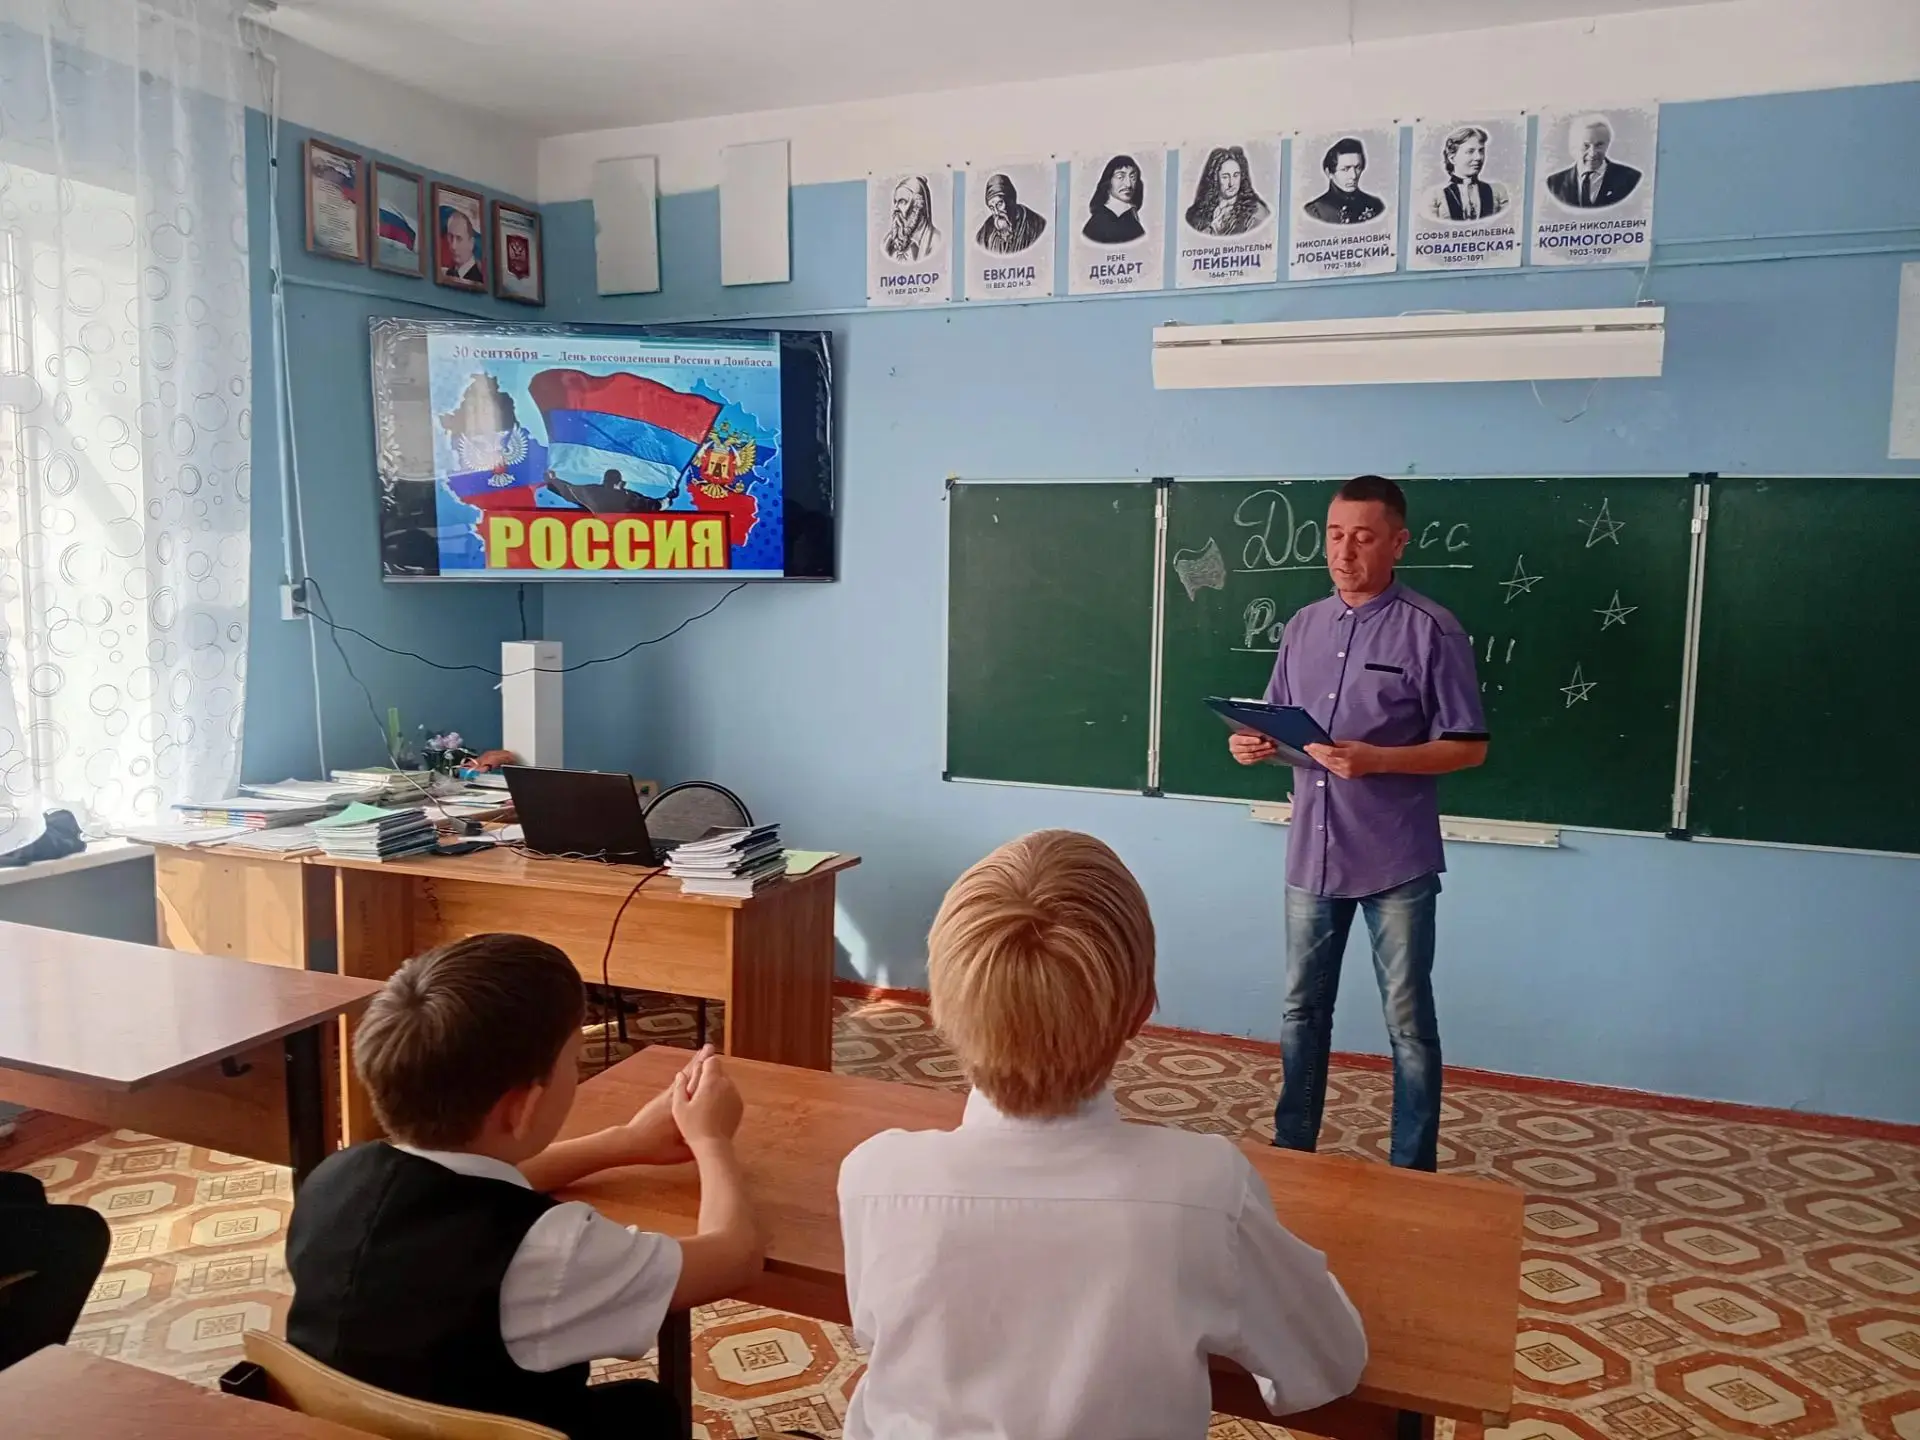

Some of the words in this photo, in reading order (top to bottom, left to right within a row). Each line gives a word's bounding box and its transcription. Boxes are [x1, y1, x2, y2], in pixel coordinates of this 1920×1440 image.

[1538, 222, 1577, 233] АНДРЕЙ
[1580, 219, 1647, 231] НИКОЛАЕВИЧ
[1296, 236, 1339, 249] НИКОЛАЙ
[1341, 233, 1391, 245] ИВАНОВИЧ
[1415, 230, 1450, 241] СОФЬЯ
[1452, 227, 1516, 239] ВАСИЛЬЕВНА
[1538, 231, 1645, 249] КОЛМОГОРОВ
[1182, 247, 1221, 258] ГОТФРИД
[1222, 243, 1273, 254] ВИЛЬГЕЛЬМ
[1296, 244, 1390, 264] ЛОБАЧЕВСКИЙ
[1415, 239, 1514, 256] КОВАЛЕВСКАЯ
[1568, 247, 1612, 256] 1903-1987
[1106, 254, 1126, 262] РЕНЕ
[1192, 252, 1261, 271] ЛЕЙБНИЦ
[1443, 254, 1484, 263] 1850-1891
[983, 266, 1036, 281] ЕВКЛИД
[1089, 262, 1144, 279] ДЕКАРТ
[880, 273, 940, 287] ПИФАГОР
[452, 345, 469, 358] 30
[472, 348, 538, 362] сентября
[558, 351, 588, 362] День
[674, 355, 710, 366] России
[723, 356, 773, 368] Донбасса
[489, 517, 724, 570] РОССИЯ
